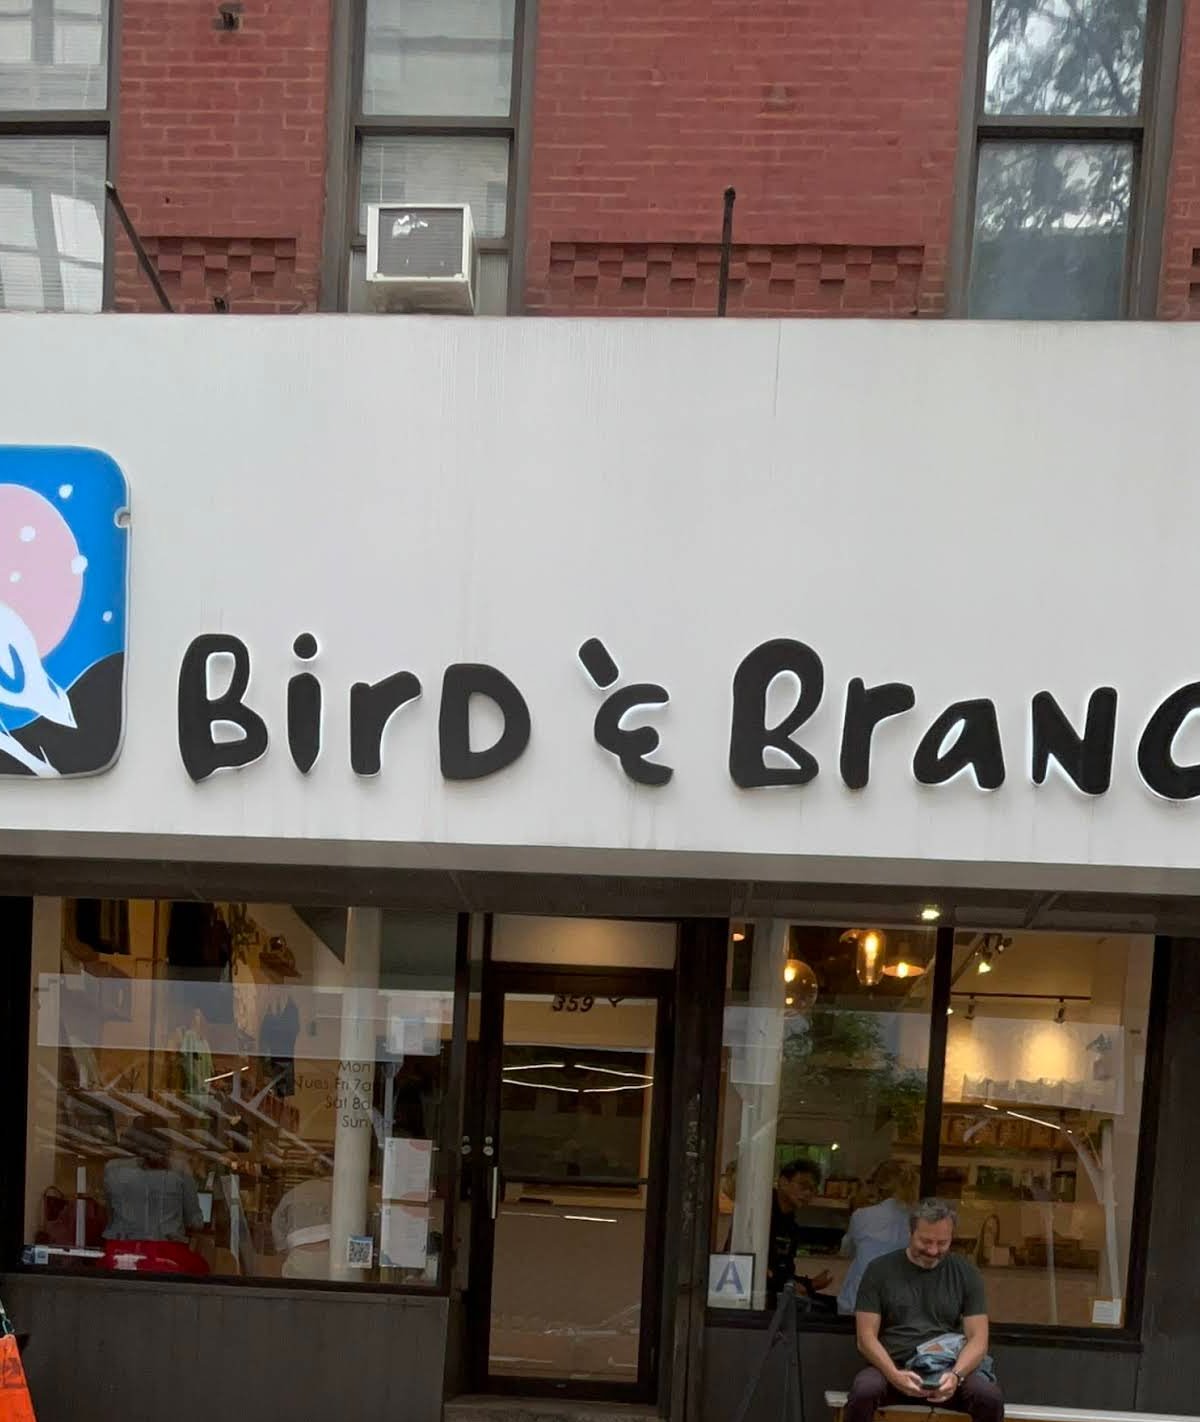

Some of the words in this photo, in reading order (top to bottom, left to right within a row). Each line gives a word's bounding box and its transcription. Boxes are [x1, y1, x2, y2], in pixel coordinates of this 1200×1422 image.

[552, 992, 595, 1012] 359
[339, 1061, 371, 1073] Mon
[342, 1115, 369, 1128] Sun
[715, 1261, 745, 1295] A
